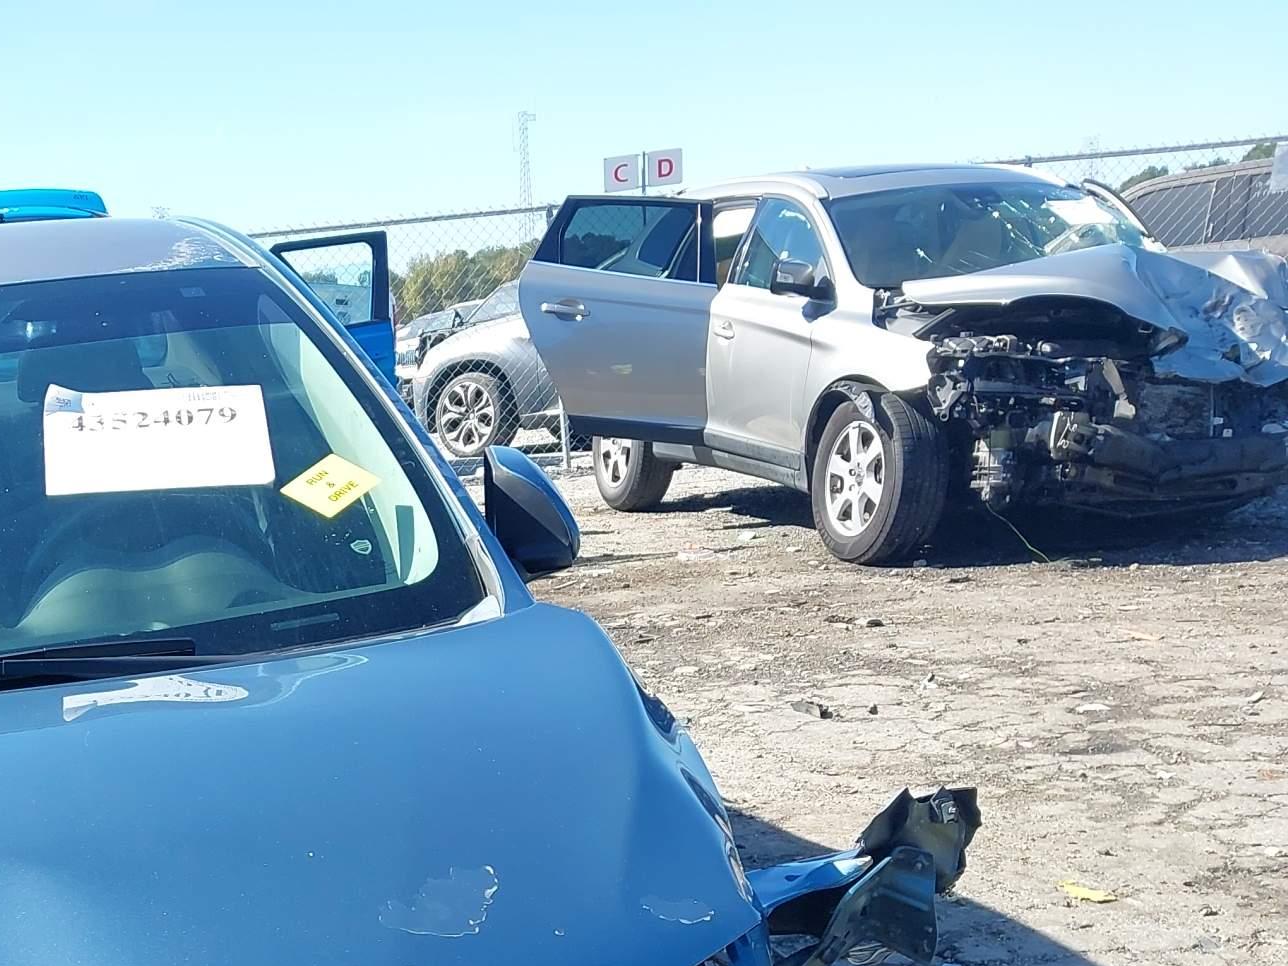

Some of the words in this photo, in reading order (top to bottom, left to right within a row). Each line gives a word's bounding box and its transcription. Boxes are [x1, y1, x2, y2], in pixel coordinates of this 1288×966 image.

[613, 163, 629, 182] C
[657, 158, 674, 178] D
[306, 470, 329, 486] RUN
[328, 480, 359, 502] DRIVE
